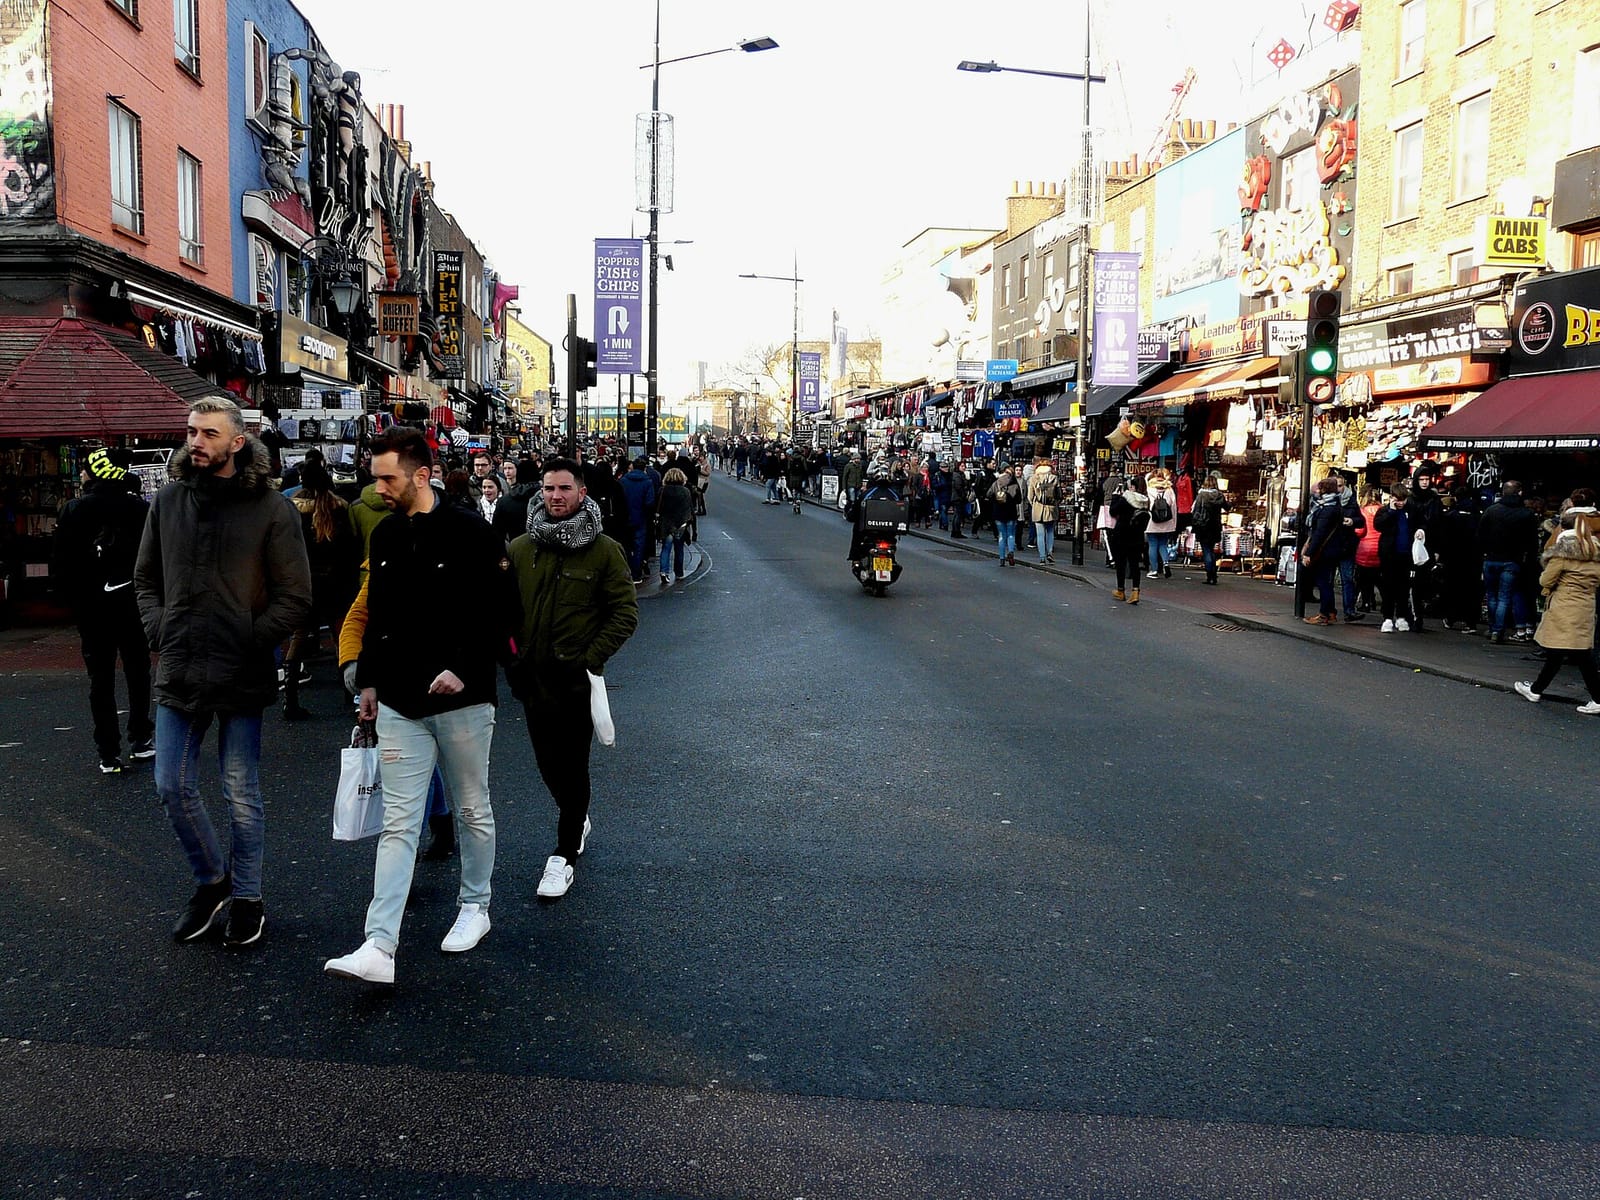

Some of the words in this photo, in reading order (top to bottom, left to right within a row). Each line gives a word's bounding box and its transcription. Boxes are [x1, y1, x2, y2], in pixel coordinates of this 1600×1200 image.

[1495, 220, 1538, 236] MINI
[1493, 238, 1538, 254] CABS
[597, 257, 640, 266] POPPIE'S
[597, 266, 631, 279] FISH
[632, 270, 640, 278] &
[597, 279, 640, 292] CHIPS
[1096, 280, 1129, 293] FISH
[1096, 292, 1136, 305] CHIPS
[382, 303, 415, 316] ORIENTAL
[449, 273, 459, 355] TATTOO
[383, 317, 414, 332] BUFFET
[1203, 322, 1237, 339] Leather
[602, 338, 609, 349] 1
[611, 338, 632, 349] MIN
[1138, 333, 1168, 343] ATHER
[1271, 333, 1307, 343] Marten
[1137, 344, 1160, 355] SHOP
[1242, 339, 1263, 351] Acce
[880, 570, 888, 578] L
